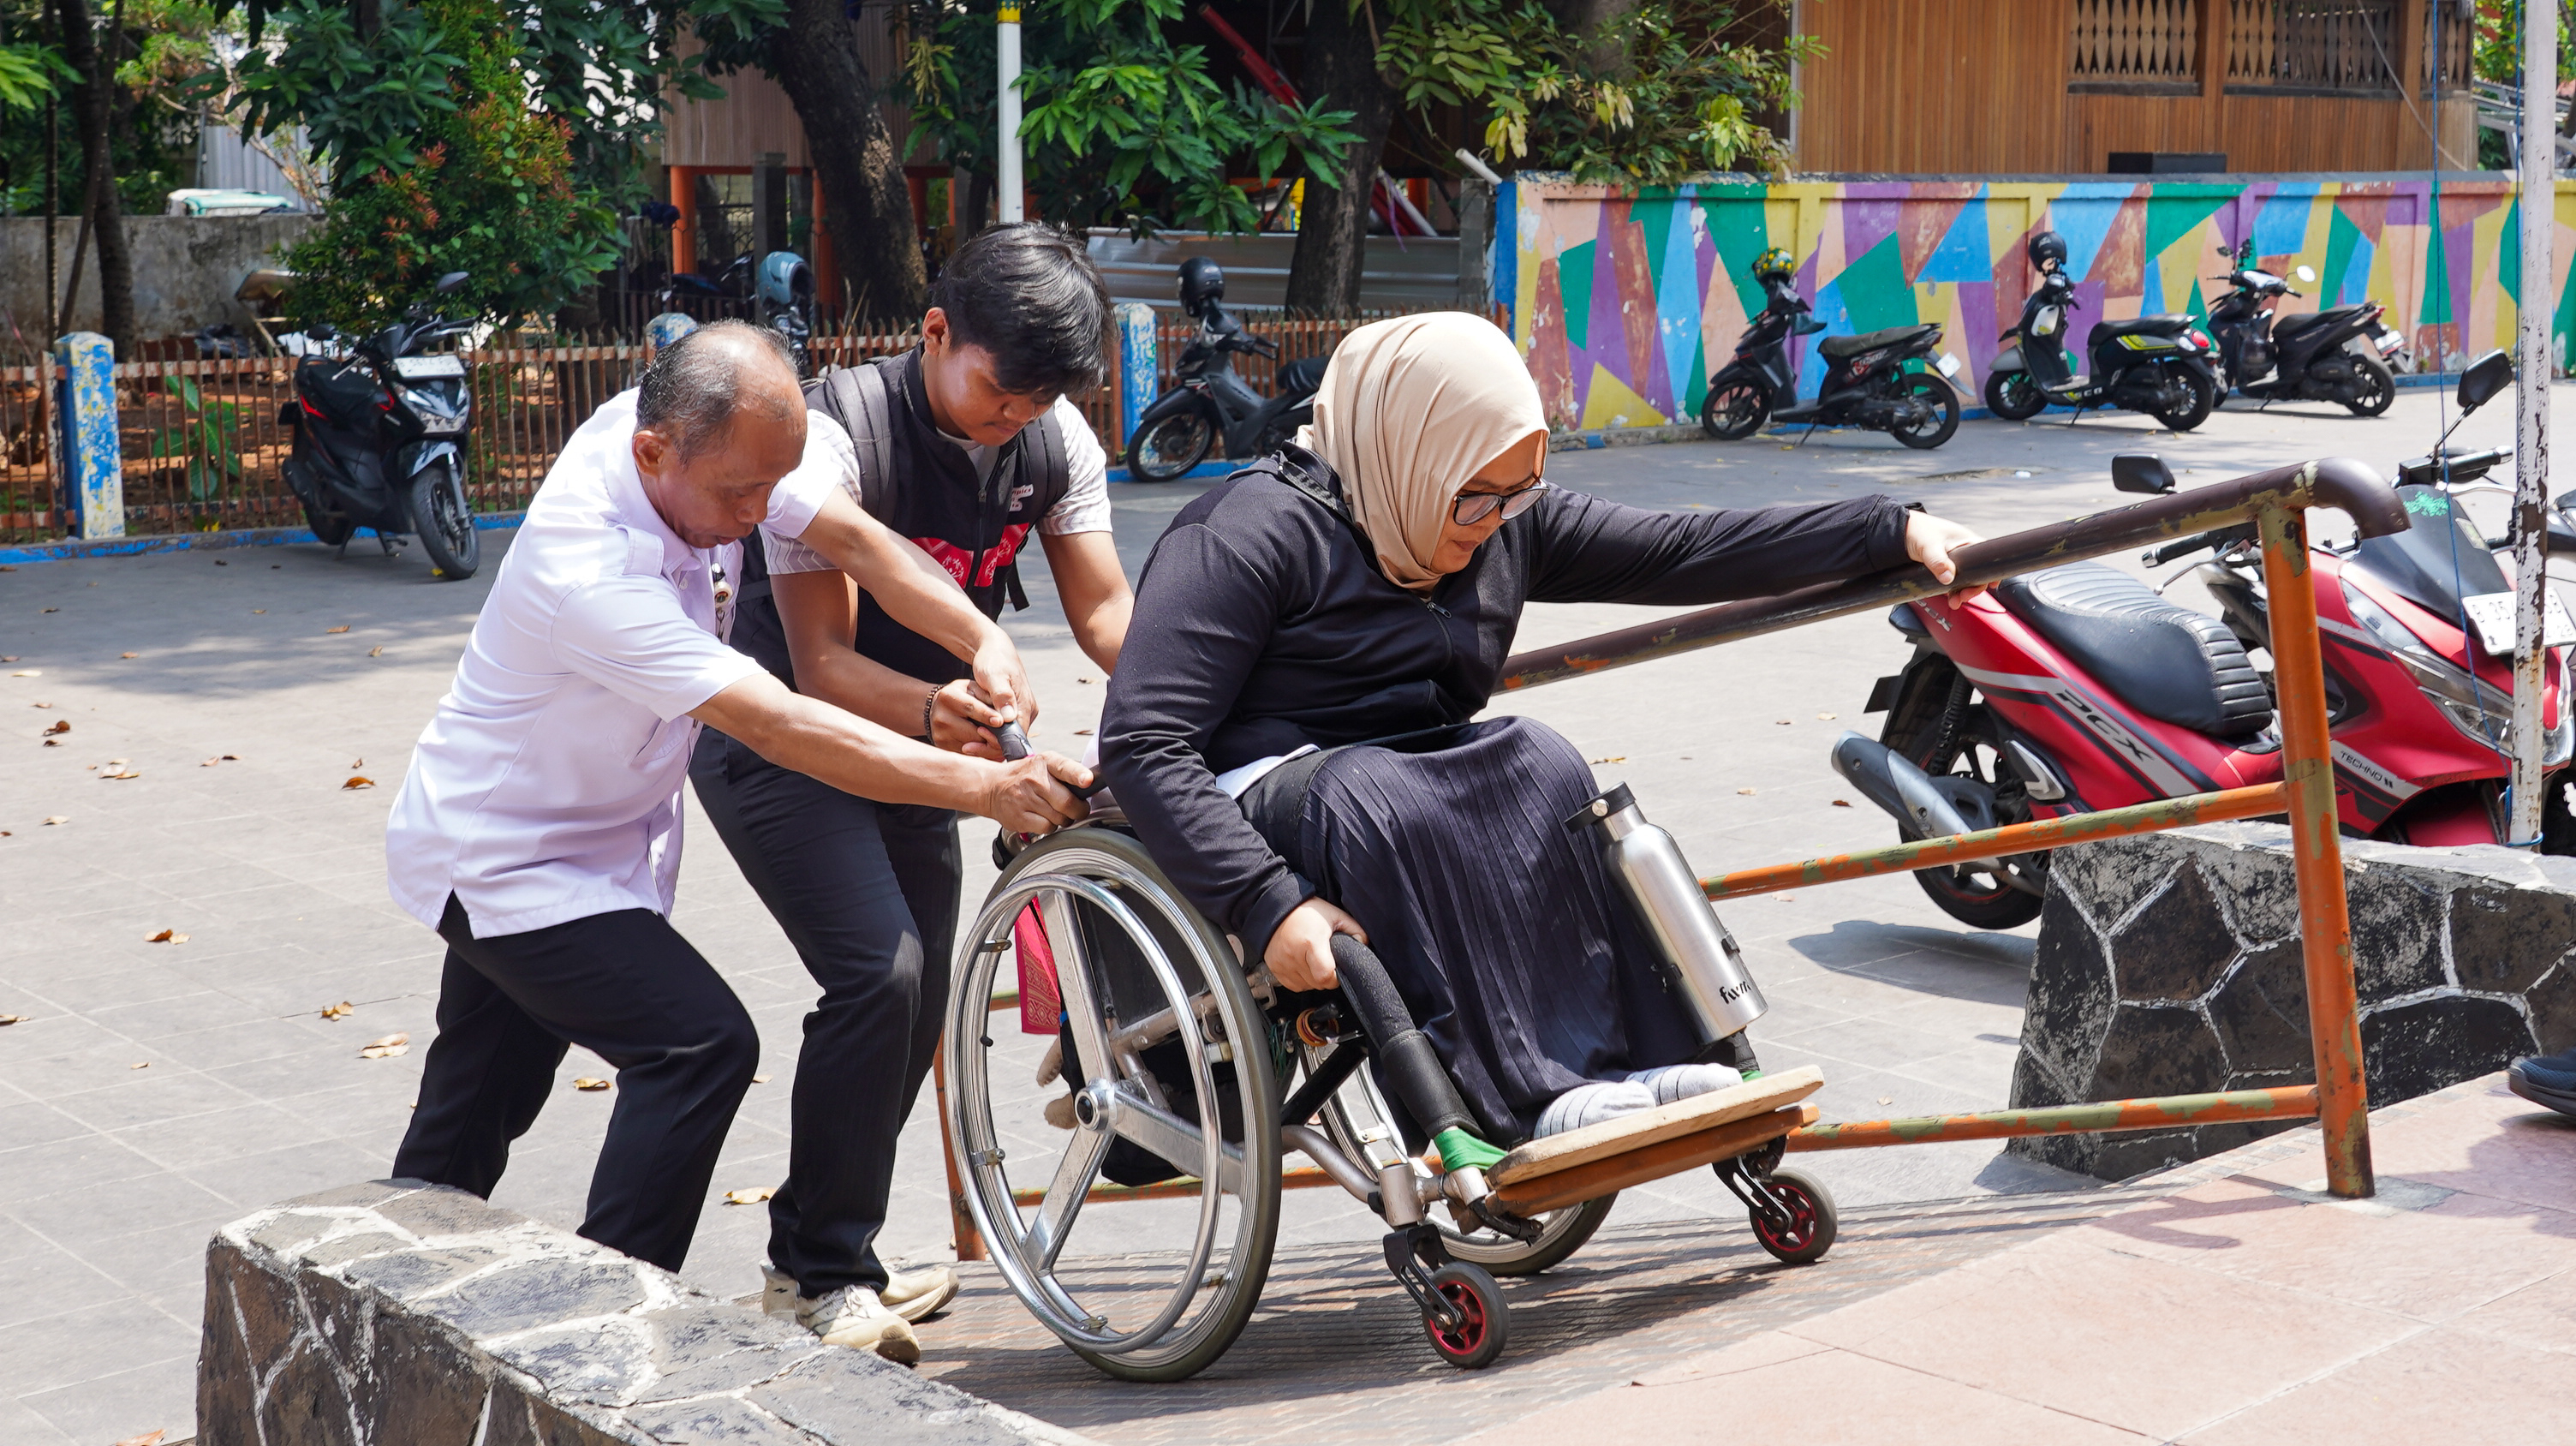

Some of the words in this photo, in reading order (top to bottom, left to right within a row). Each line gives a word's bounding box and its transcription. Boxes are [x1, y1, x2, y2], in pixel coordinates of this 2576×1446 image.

[2472, 604, 2485, 623] B
[2055, 689, 2155, 762] PCX
[2340, 750, 2382, 781] TECHNO
